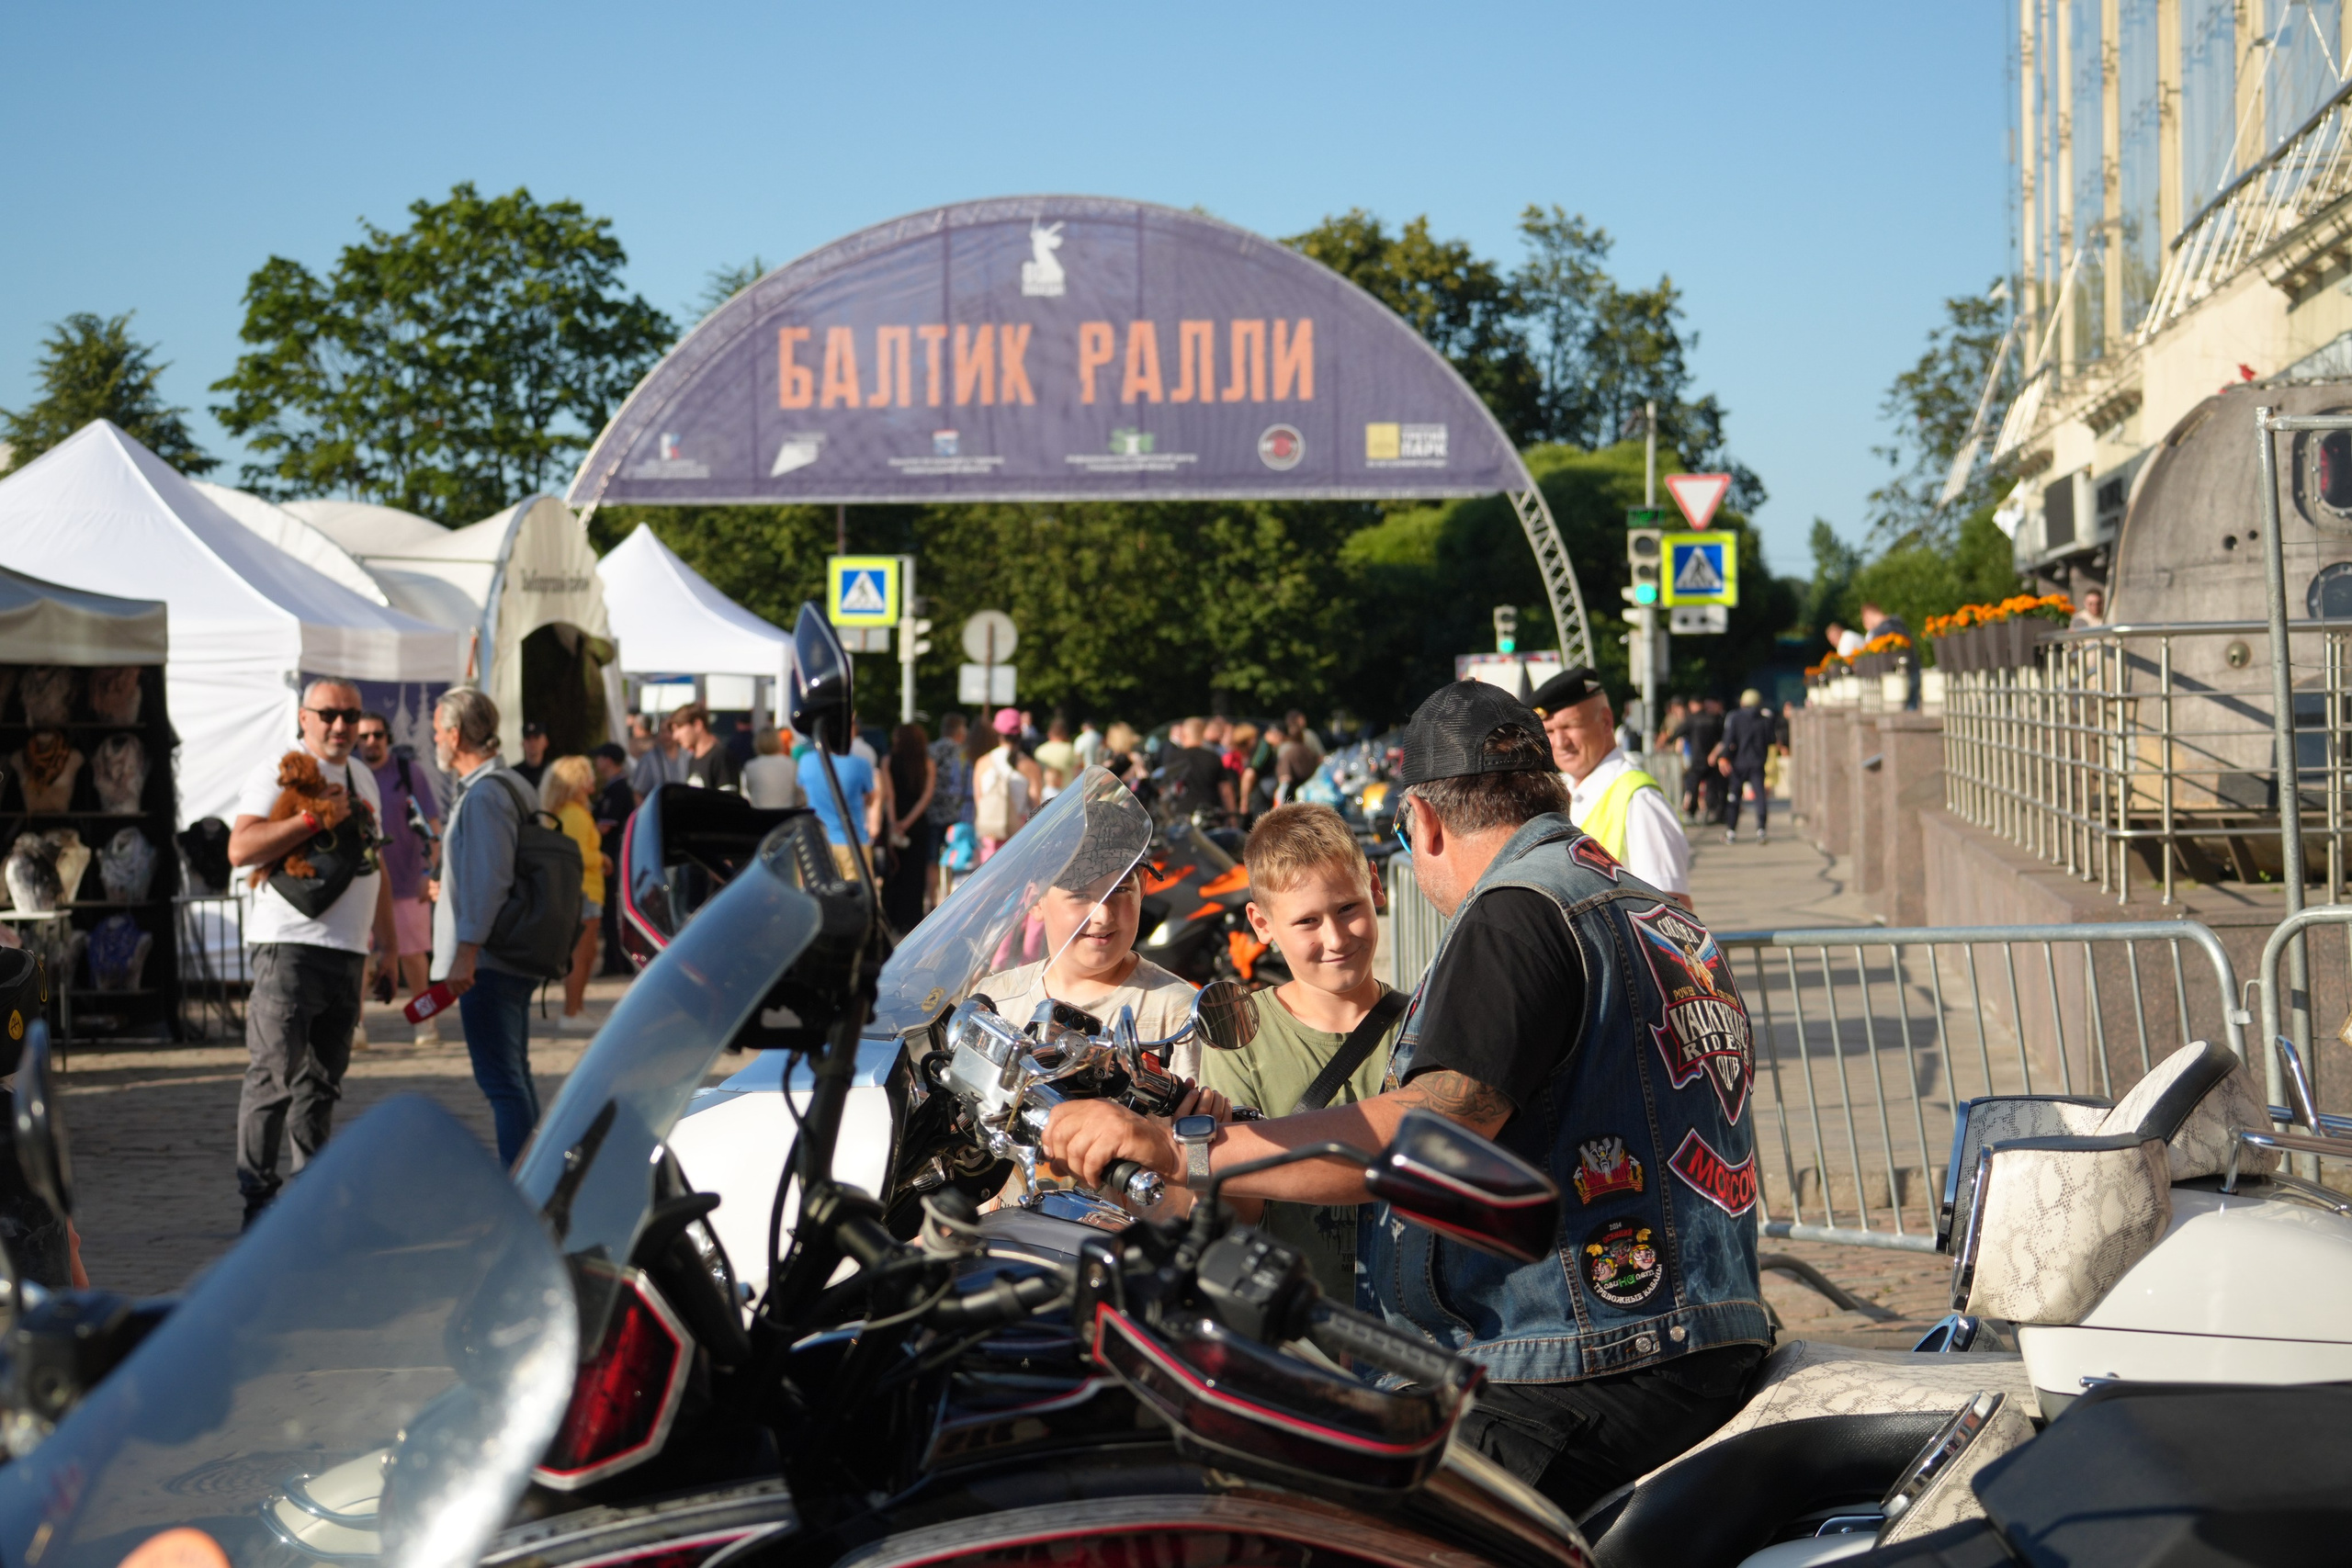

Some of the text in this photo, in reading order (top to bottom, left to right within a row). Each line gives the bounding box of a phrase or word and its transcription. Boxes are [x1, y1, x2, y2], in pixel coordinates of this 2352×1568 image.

[778, 317, 1315, 410] БАЛТИК РАЛЛИ
[1673, 986, 1696, 1001] POWER
[1715, 1055, 1740, 1091] CLUB
[1609, 1222, 1623, 1231] 2014
[1593, 1264, 1663, 1303] ТРЕВОЖНЫЕ КАБАНЫ
